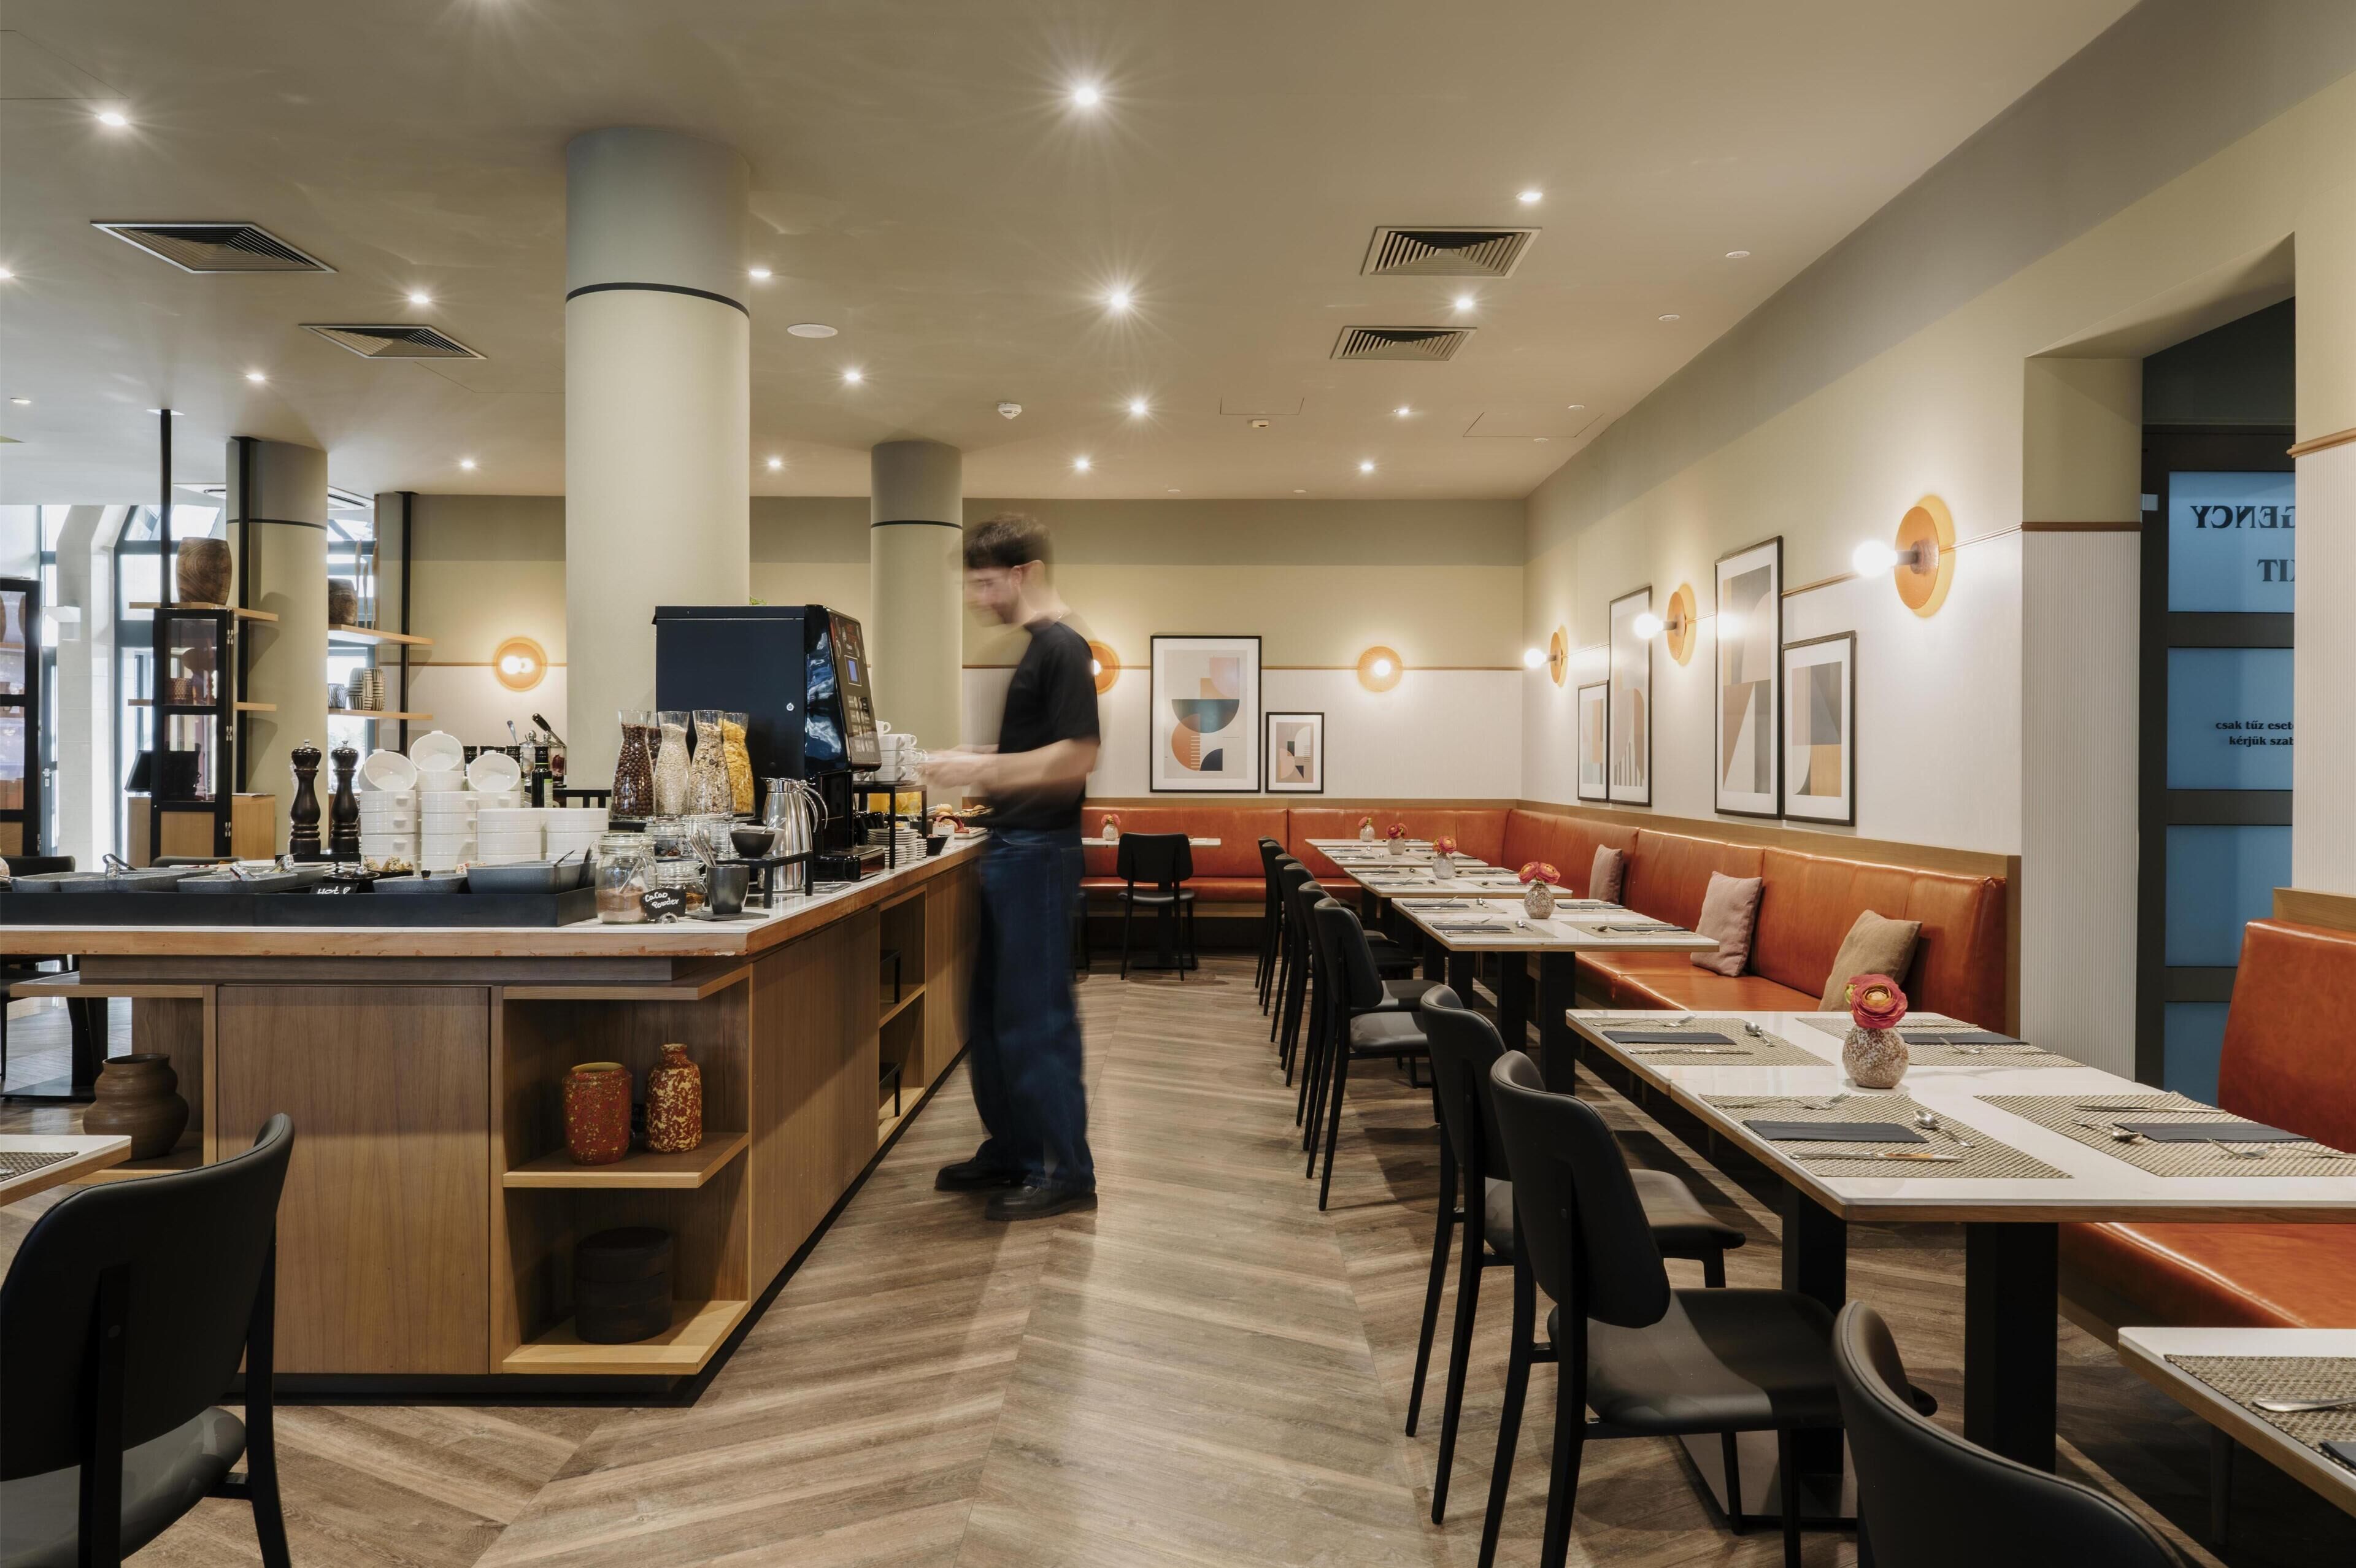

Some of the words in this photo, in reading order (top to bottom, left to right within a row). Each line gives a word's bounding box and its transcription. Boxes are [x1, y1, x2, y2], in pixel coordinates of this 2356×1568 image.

[2215, 721, 2242, 729] csak
[2246, 720, 2264, 729] tűz
[2268, 721, 2293, 729] eset
[2229, 736, 2266, 747] kérjük
